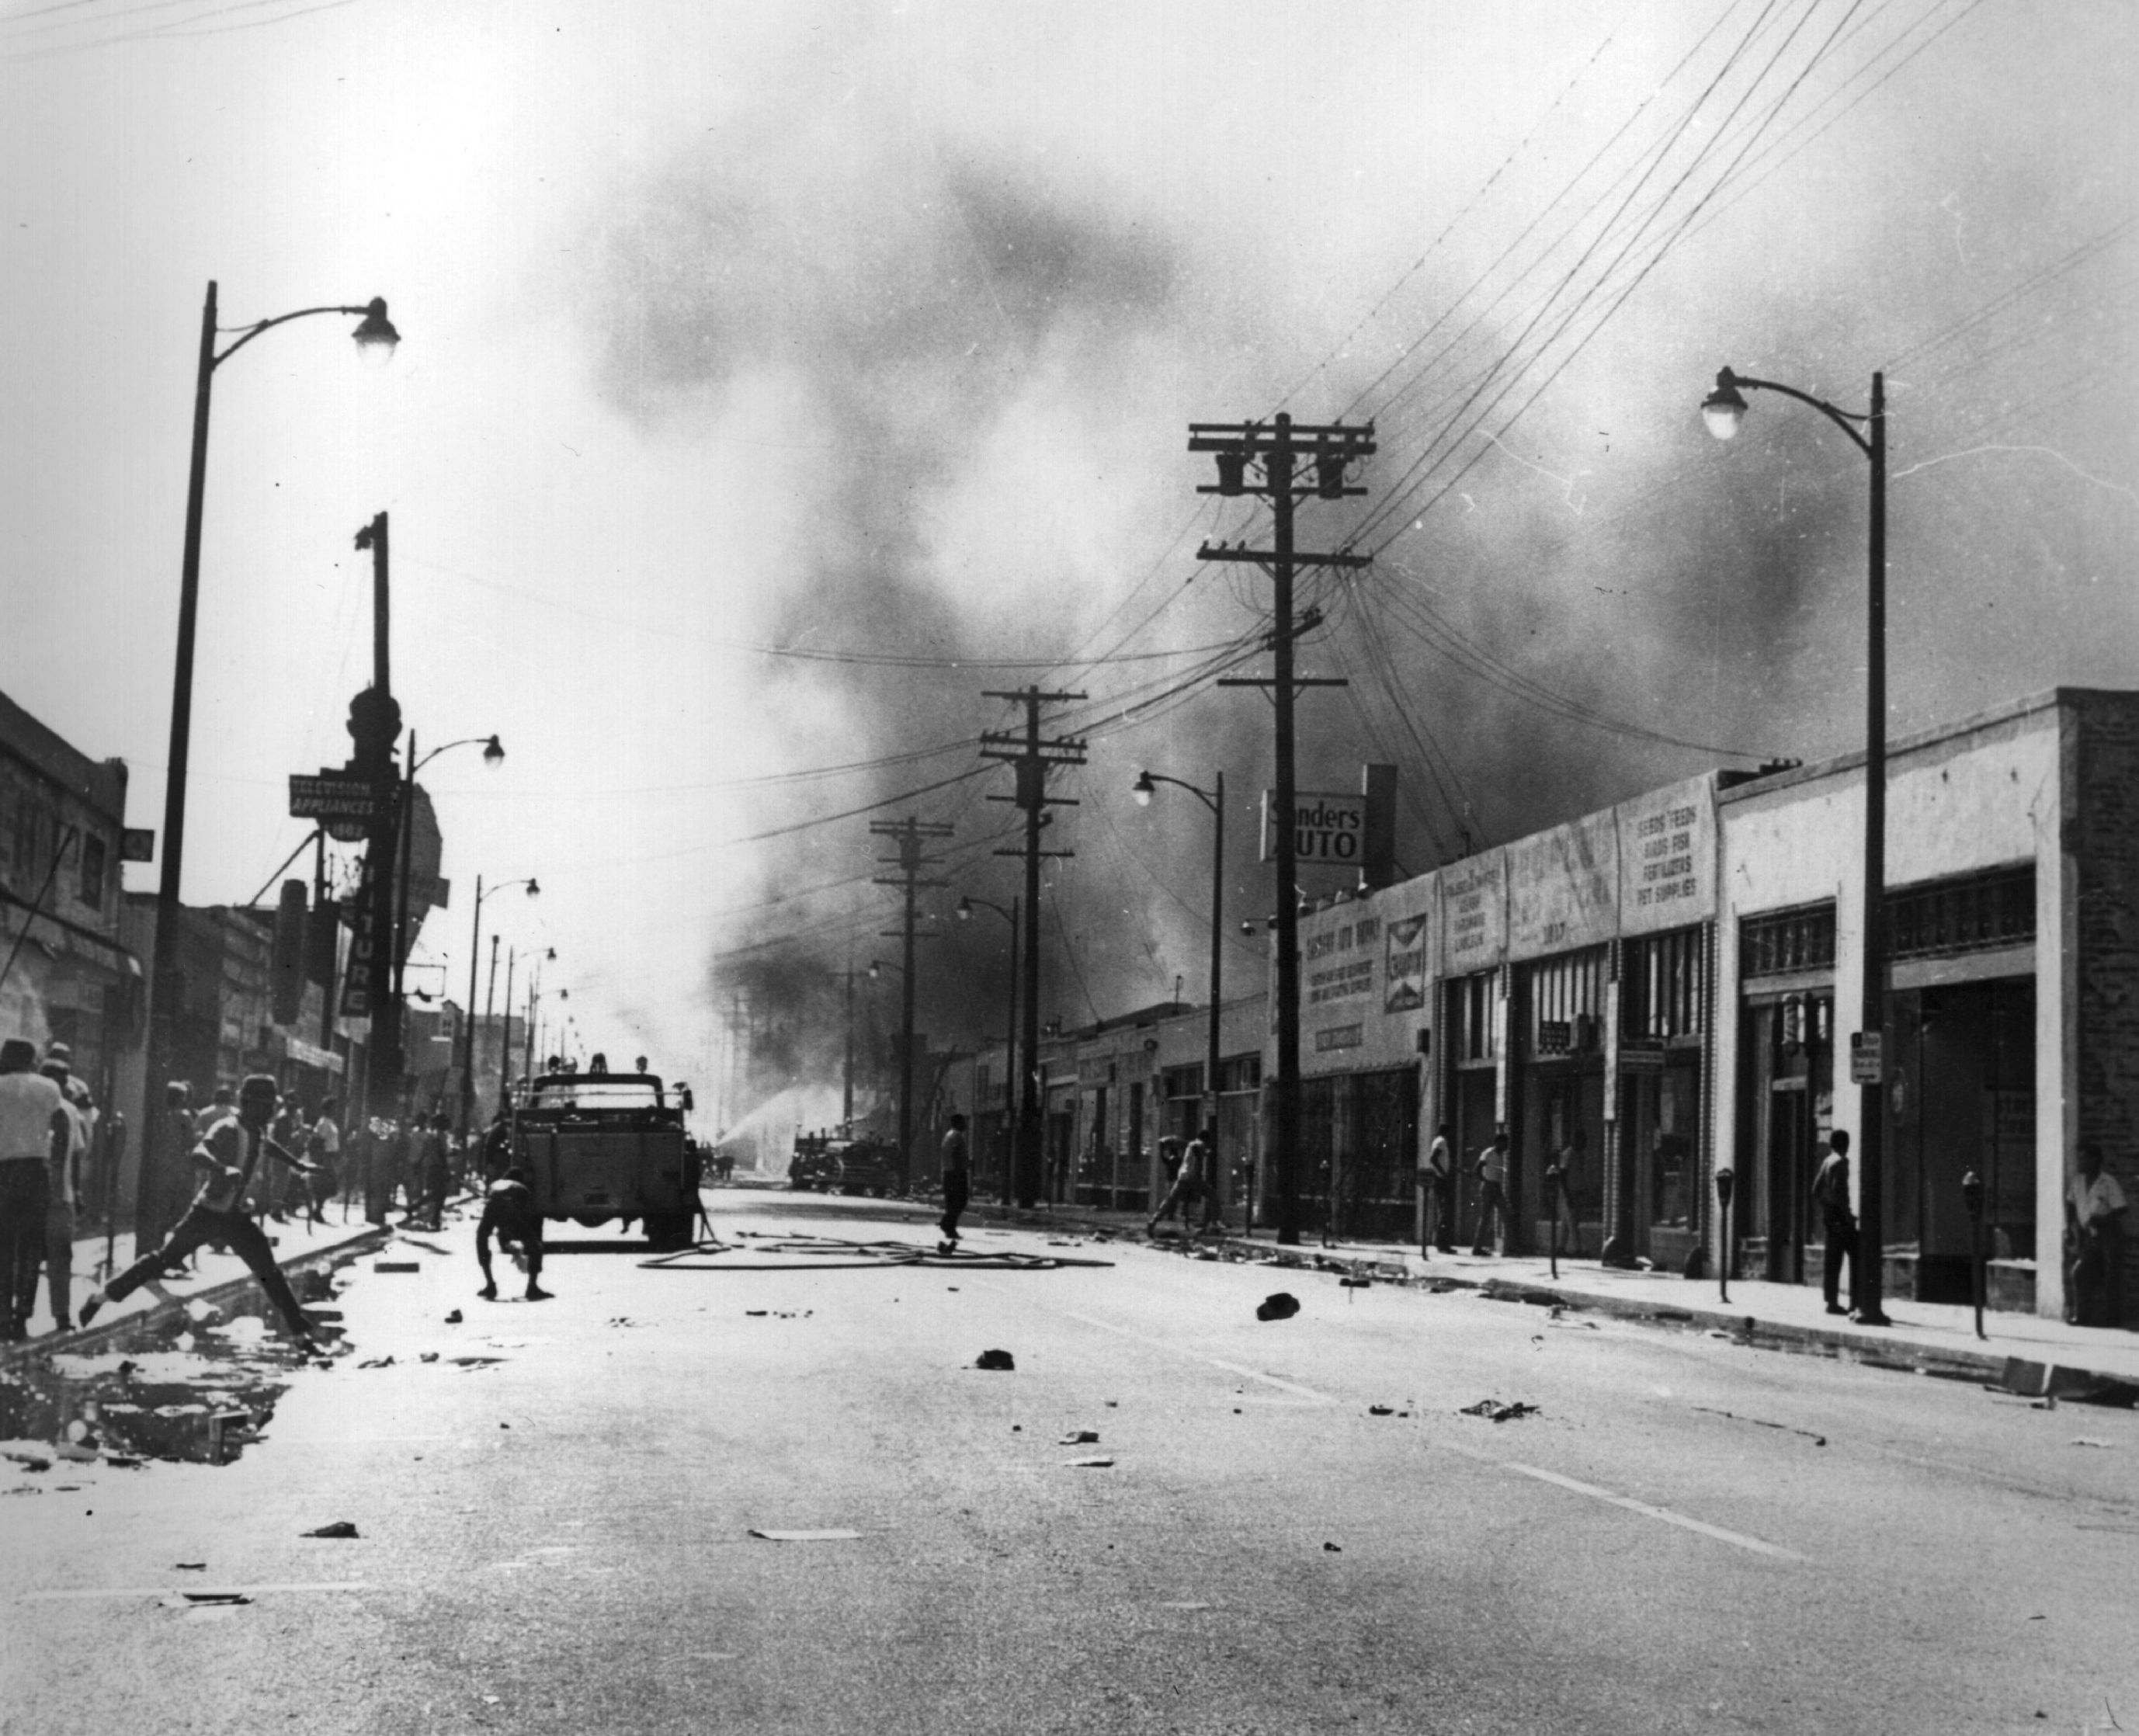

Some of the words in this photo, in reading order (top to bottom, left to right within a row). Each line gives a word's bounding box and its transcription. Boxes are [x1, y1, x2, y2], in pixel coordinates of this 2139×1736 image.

[292, 779, 371, 797] TELEVISION
[292, 797, 374, 815] APPLIANCES
[1272, 829, 1357, 859] UTO
[1655, 877, 1696, 903] SUPPLIES
